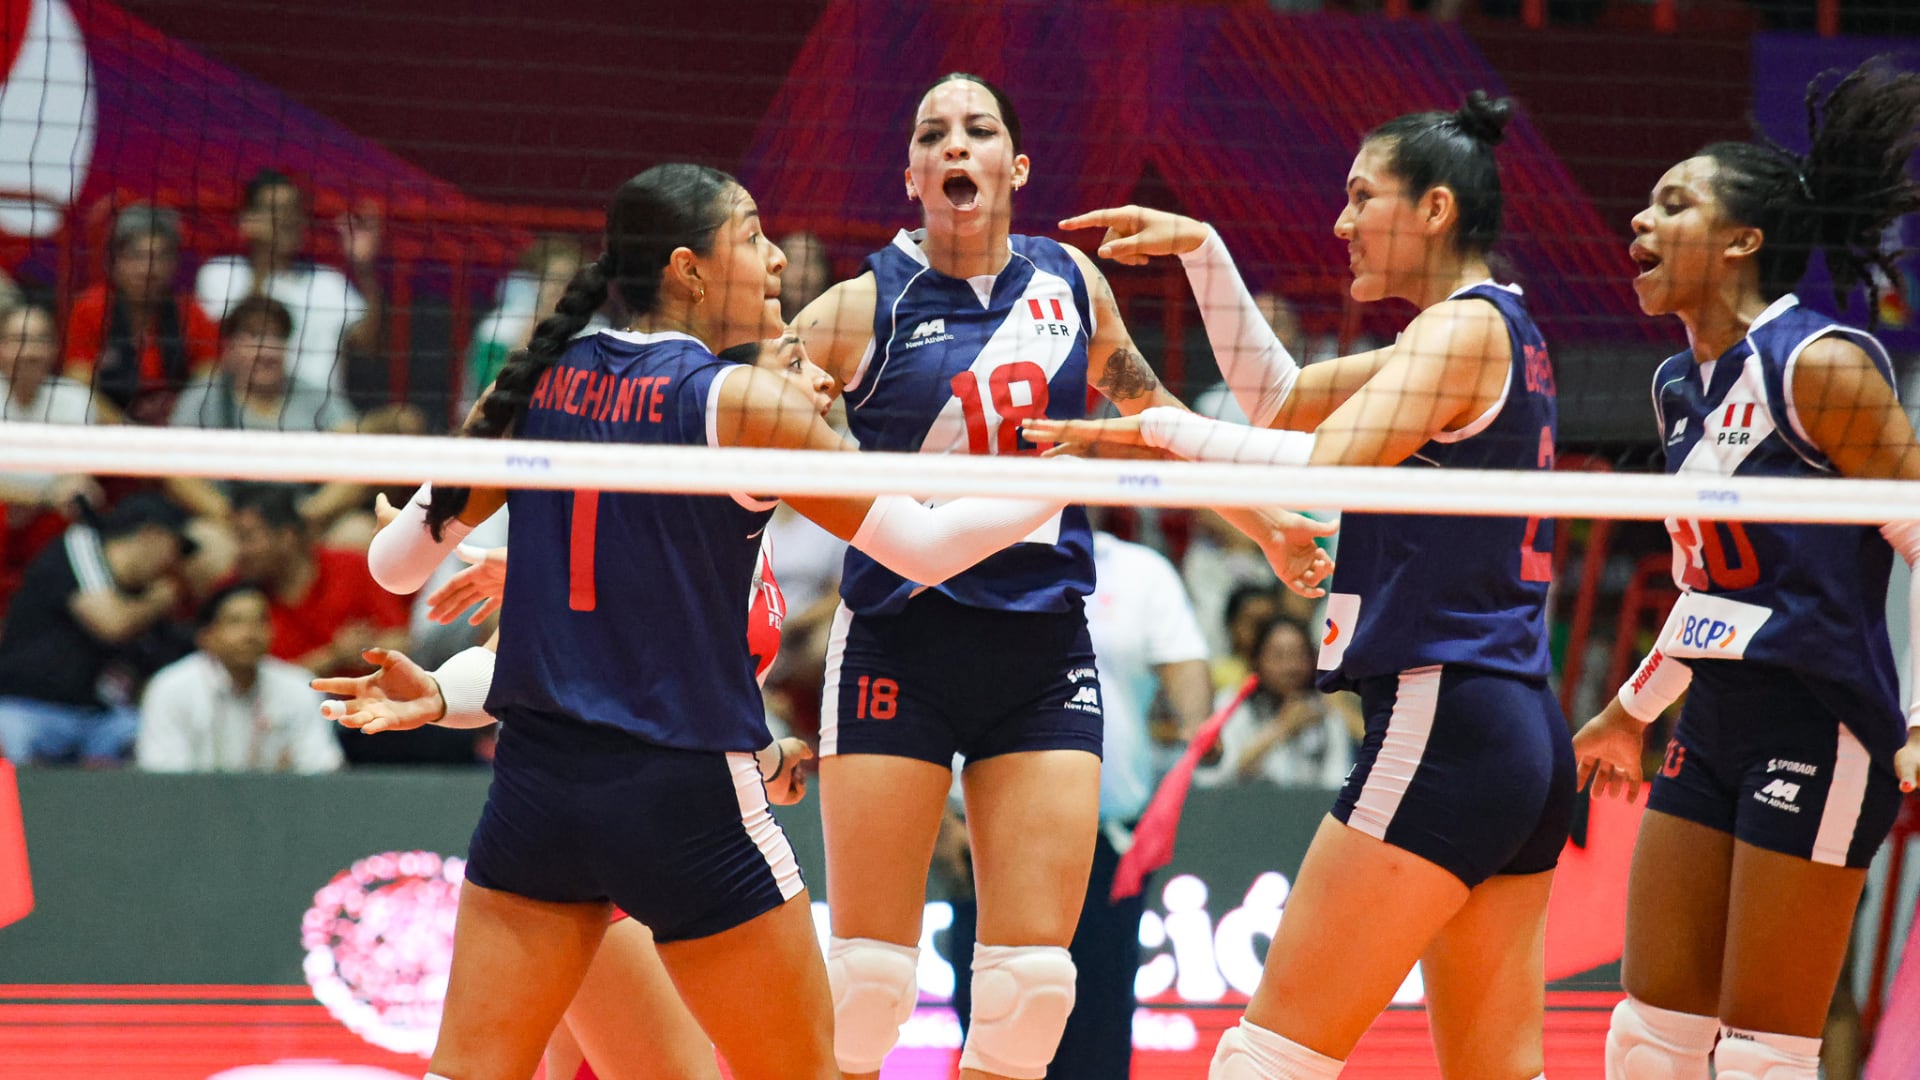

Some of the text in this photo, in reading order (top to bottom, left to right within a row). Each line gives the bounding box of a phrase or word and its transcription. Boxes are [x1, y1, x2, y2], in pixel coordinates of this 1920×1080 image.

[1034, 322, 1070, 337] PER
[950, 361, 1055, 456] 18
[1716, 431, 1751, 446] PER
[768, 612, 781, 632] PE
[1683, 615, 1726, 649] BCP
[857, 675, 899, 720] 18
[1768, 798, 1801, 813] Athletic
